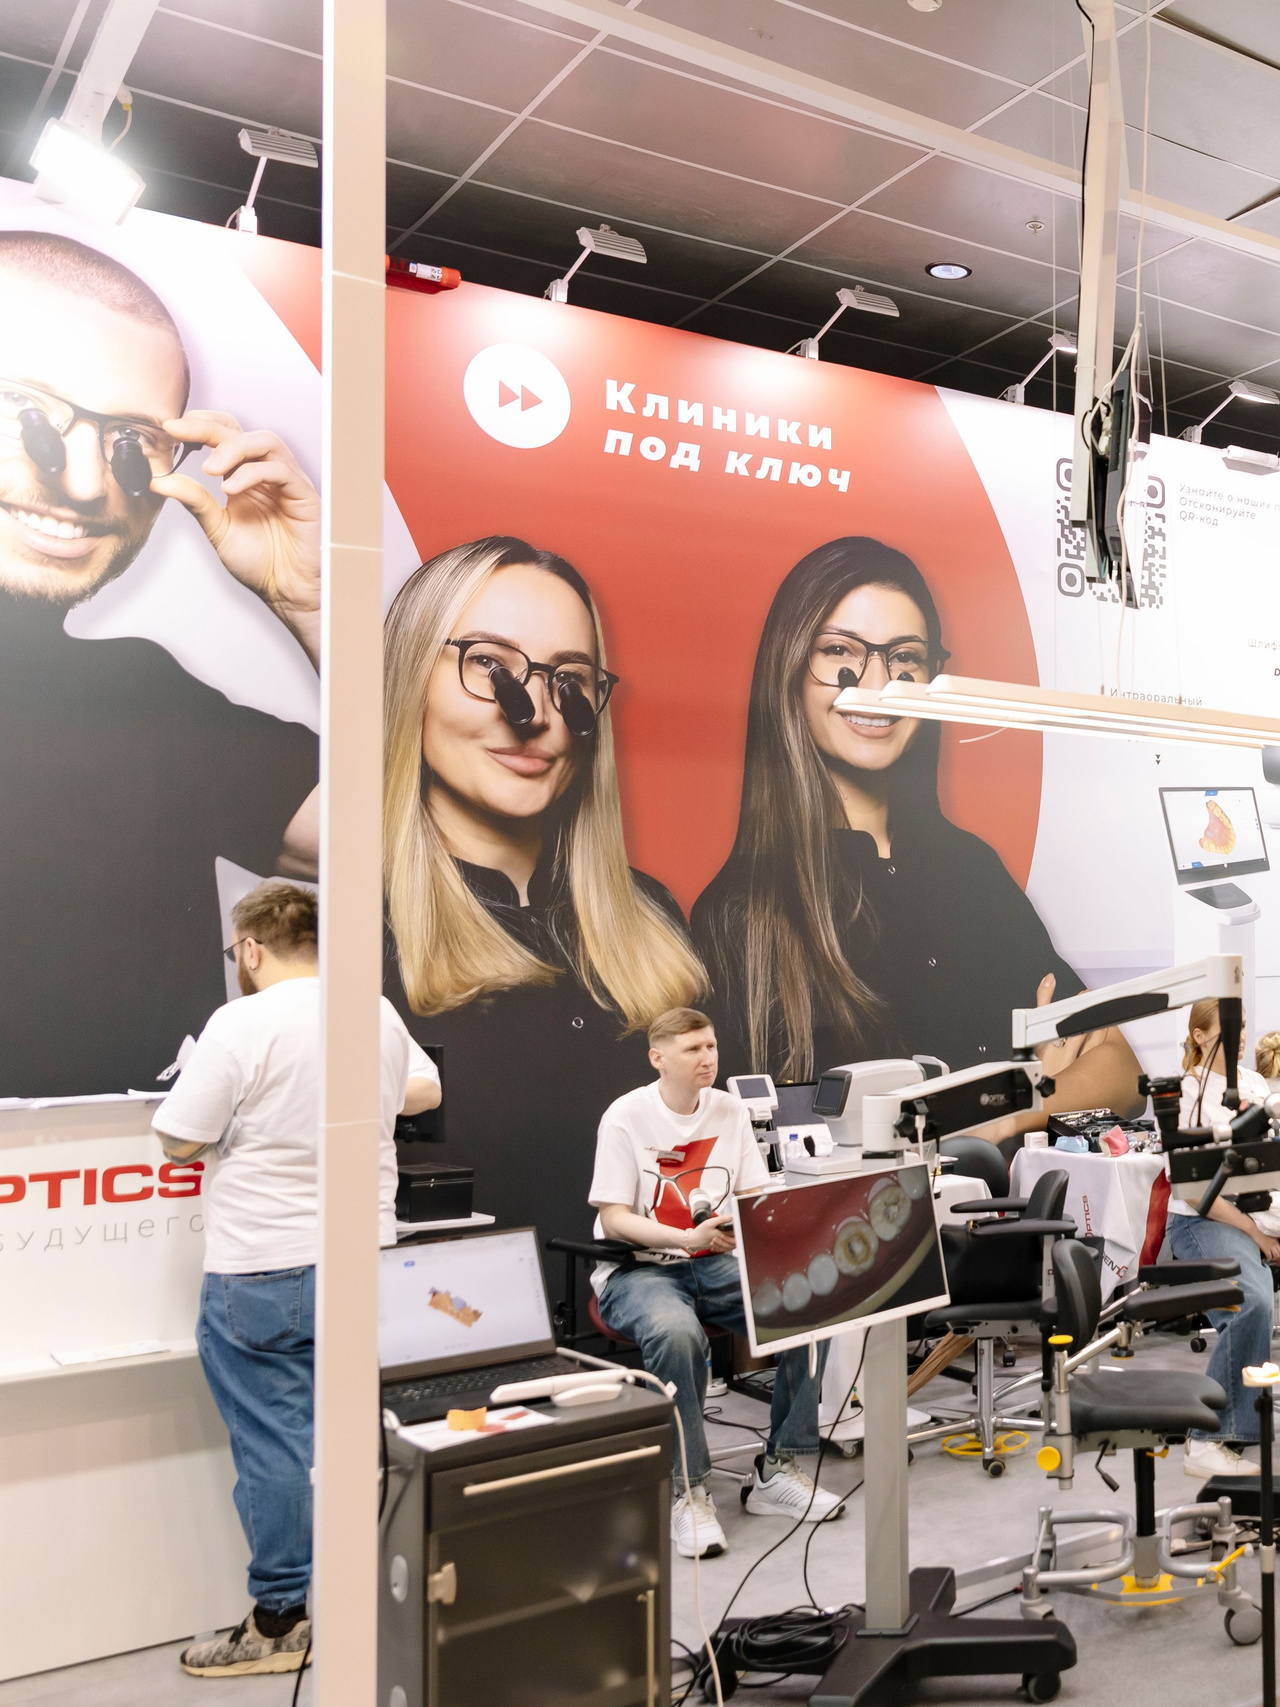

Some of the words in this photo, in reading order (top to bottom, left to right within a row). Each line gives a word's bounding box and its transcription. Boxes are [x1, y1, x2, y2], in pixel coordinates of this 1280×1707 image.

[606, 379, 832, 450] Клиники
[604, 429, 700, 472] под
[725, 451, 851, 492] ключ
[1179, 483, 1224, 501] Узнайте
[1227, 494, 1234, 502] о
[1237, 497, 1270, 510] наших
[1179, 496, 1257, 520] Отсканируйте
[1179, 510, 1219, 527] QR-код
